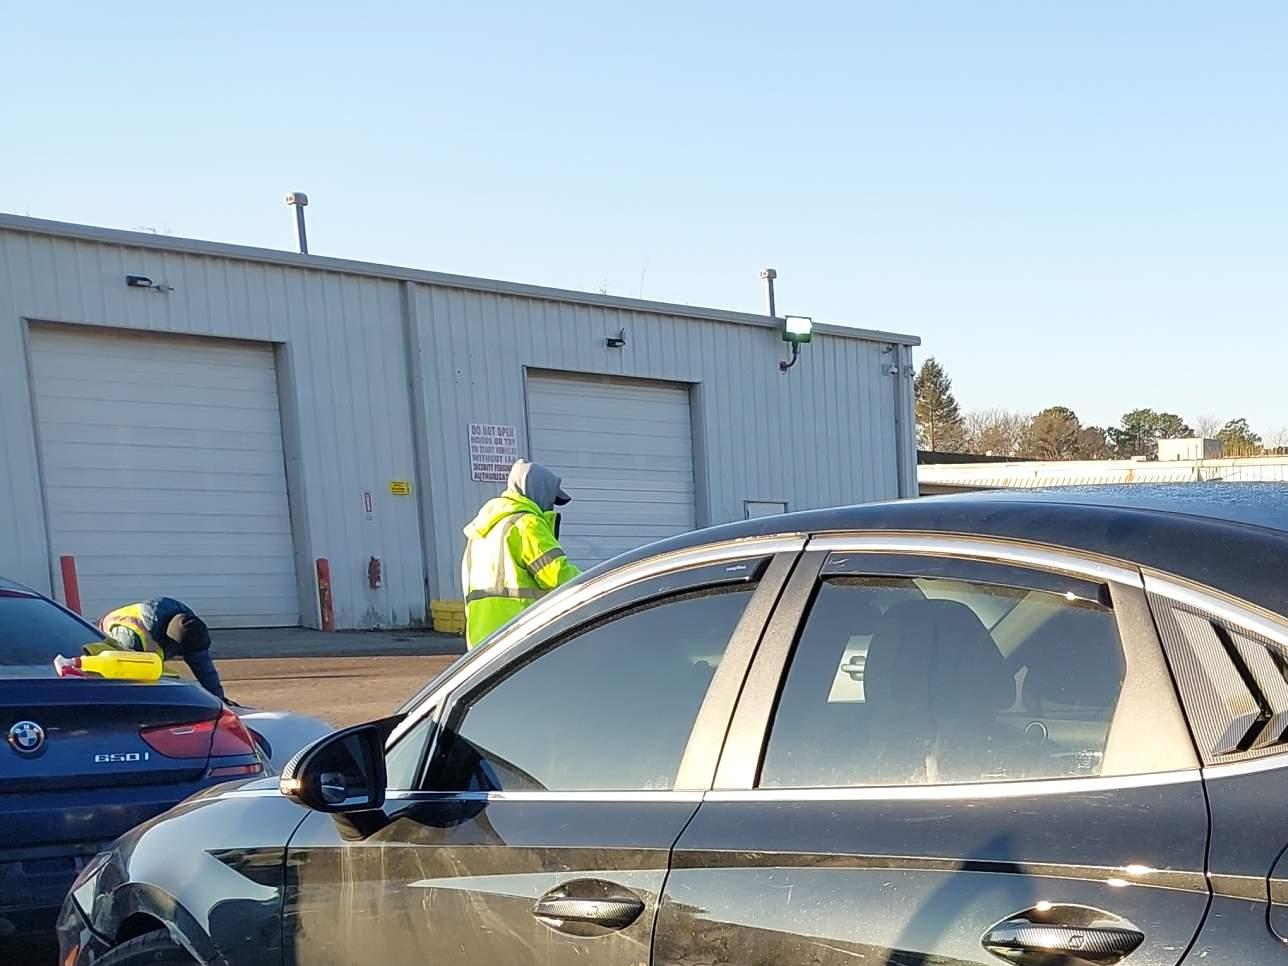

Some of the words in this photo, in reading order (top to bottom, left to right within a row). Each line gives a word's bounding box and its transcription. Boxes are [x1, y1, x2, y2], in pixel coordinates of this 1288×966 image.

[471, 425, 481, 436] DO
[482, 425, 496, 436] NOT
[497, 426, 514, 437] OPEN
[471, 436, 492, 445] HOODS
[493, 437, 503, 445] OR
[504, 438, 516, 446] TRY
[471, 445, 479, 453] TO
[479, 445, 495, 454] START
[495, 446, 517, 455] VEHICLES
[472, 454, 503, 463] WITHOUT
[473, 463, 494, 471] SECURITY
[474, 472, 509, 480] AUTHORIZAT
